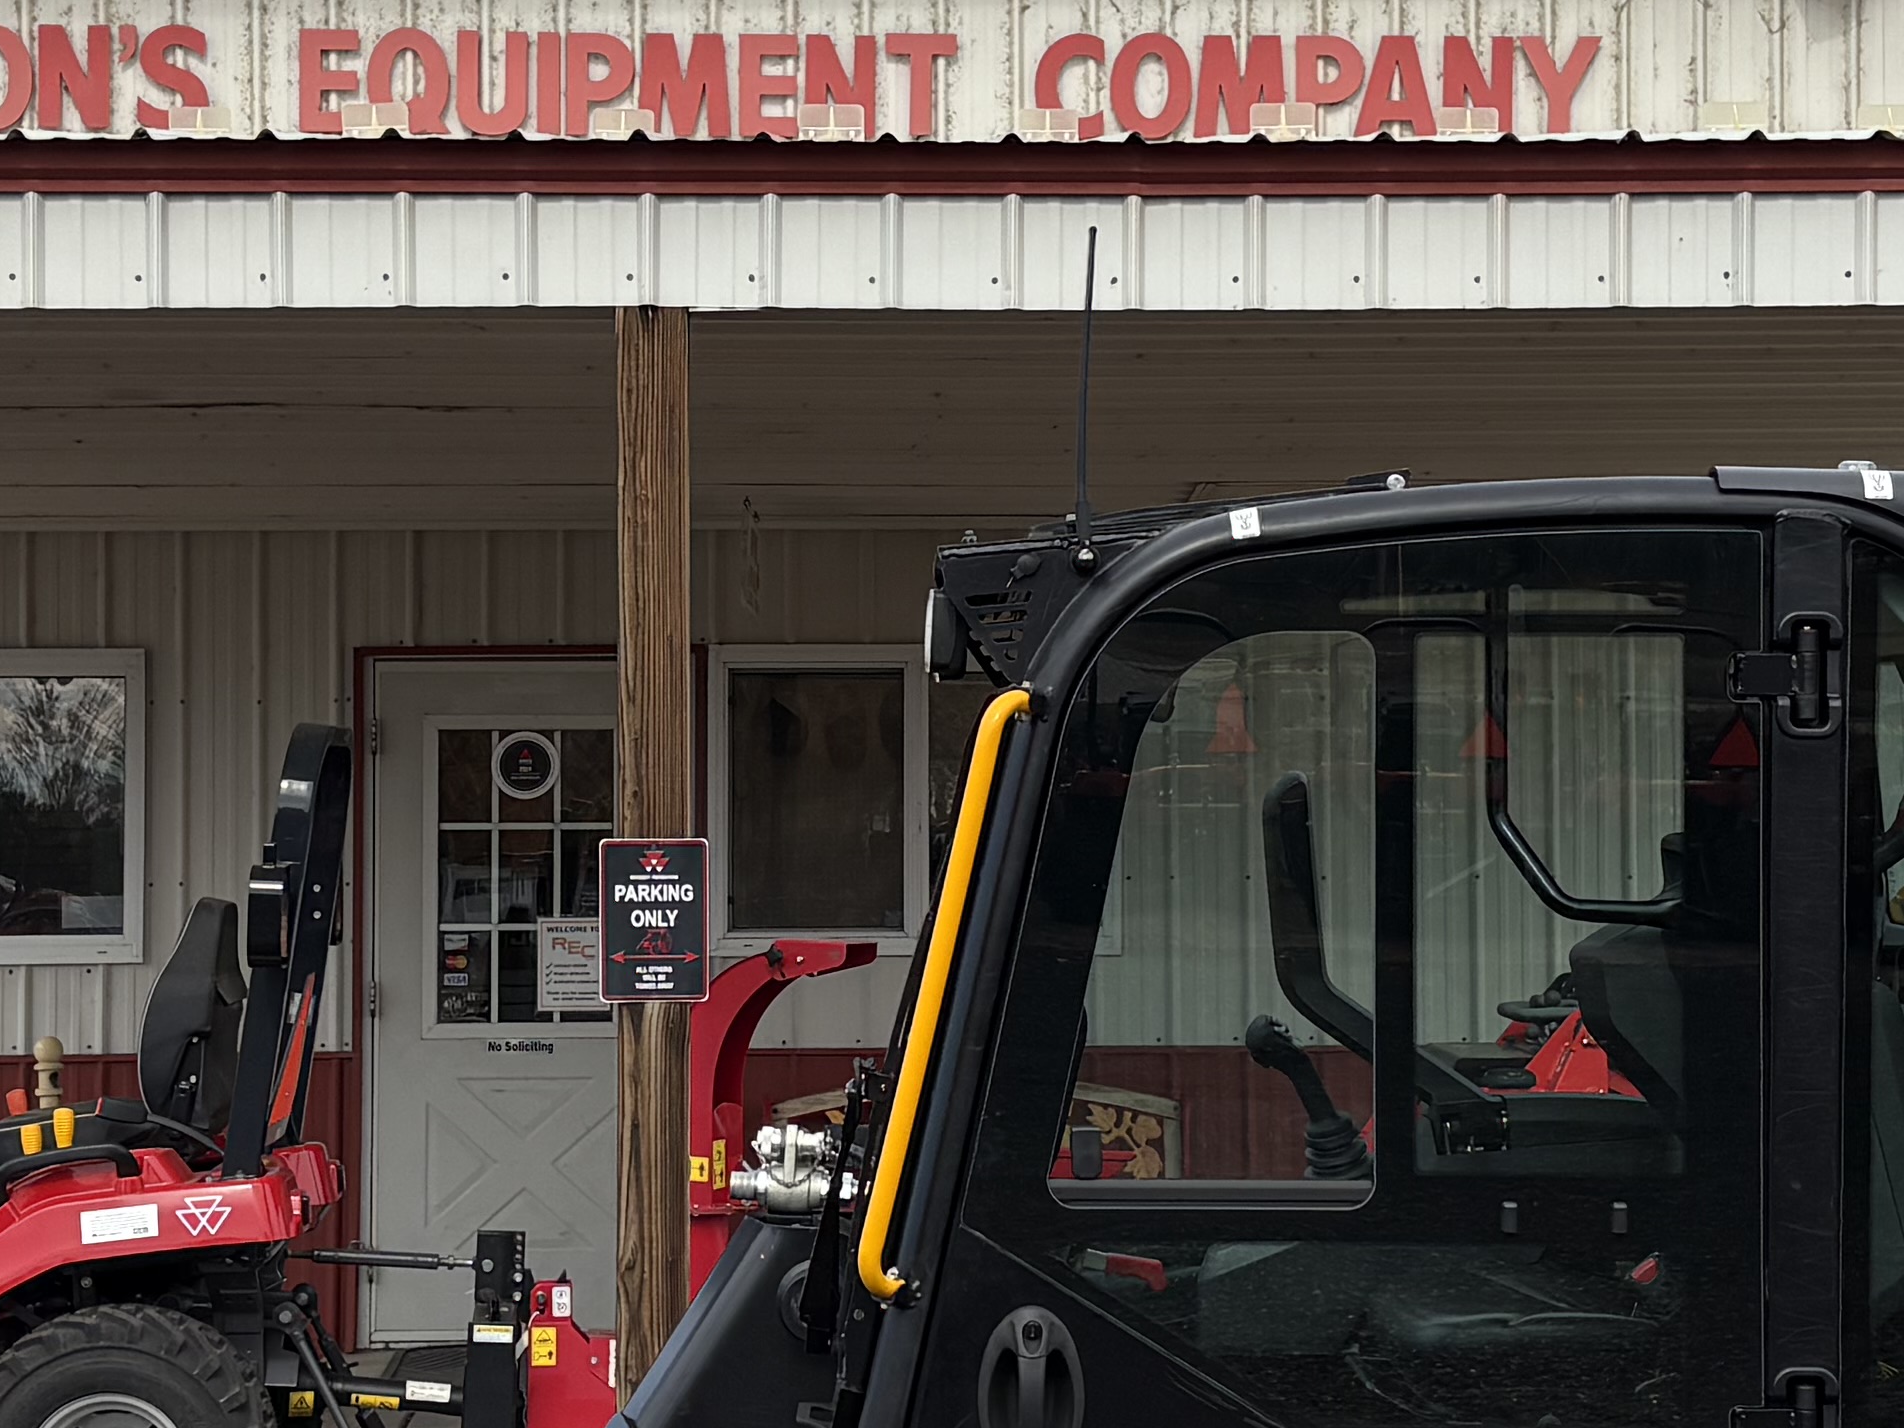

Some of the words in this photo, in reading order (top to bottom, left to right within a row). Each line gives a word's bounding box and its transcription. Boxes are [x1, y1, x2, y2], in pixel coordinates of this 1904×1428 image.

[299, 27, 958, 139] EQUIPMENT
[1035, 32, 1603, 139] COMPANY
[614, 883, 694, 902] PARKING
[630, 909, 678, 927] ONLY
[552, 937, 596, 960] REC
[487, 1041, 502, 1052] No
[504, 1040, 554, 1055] Soliciting
